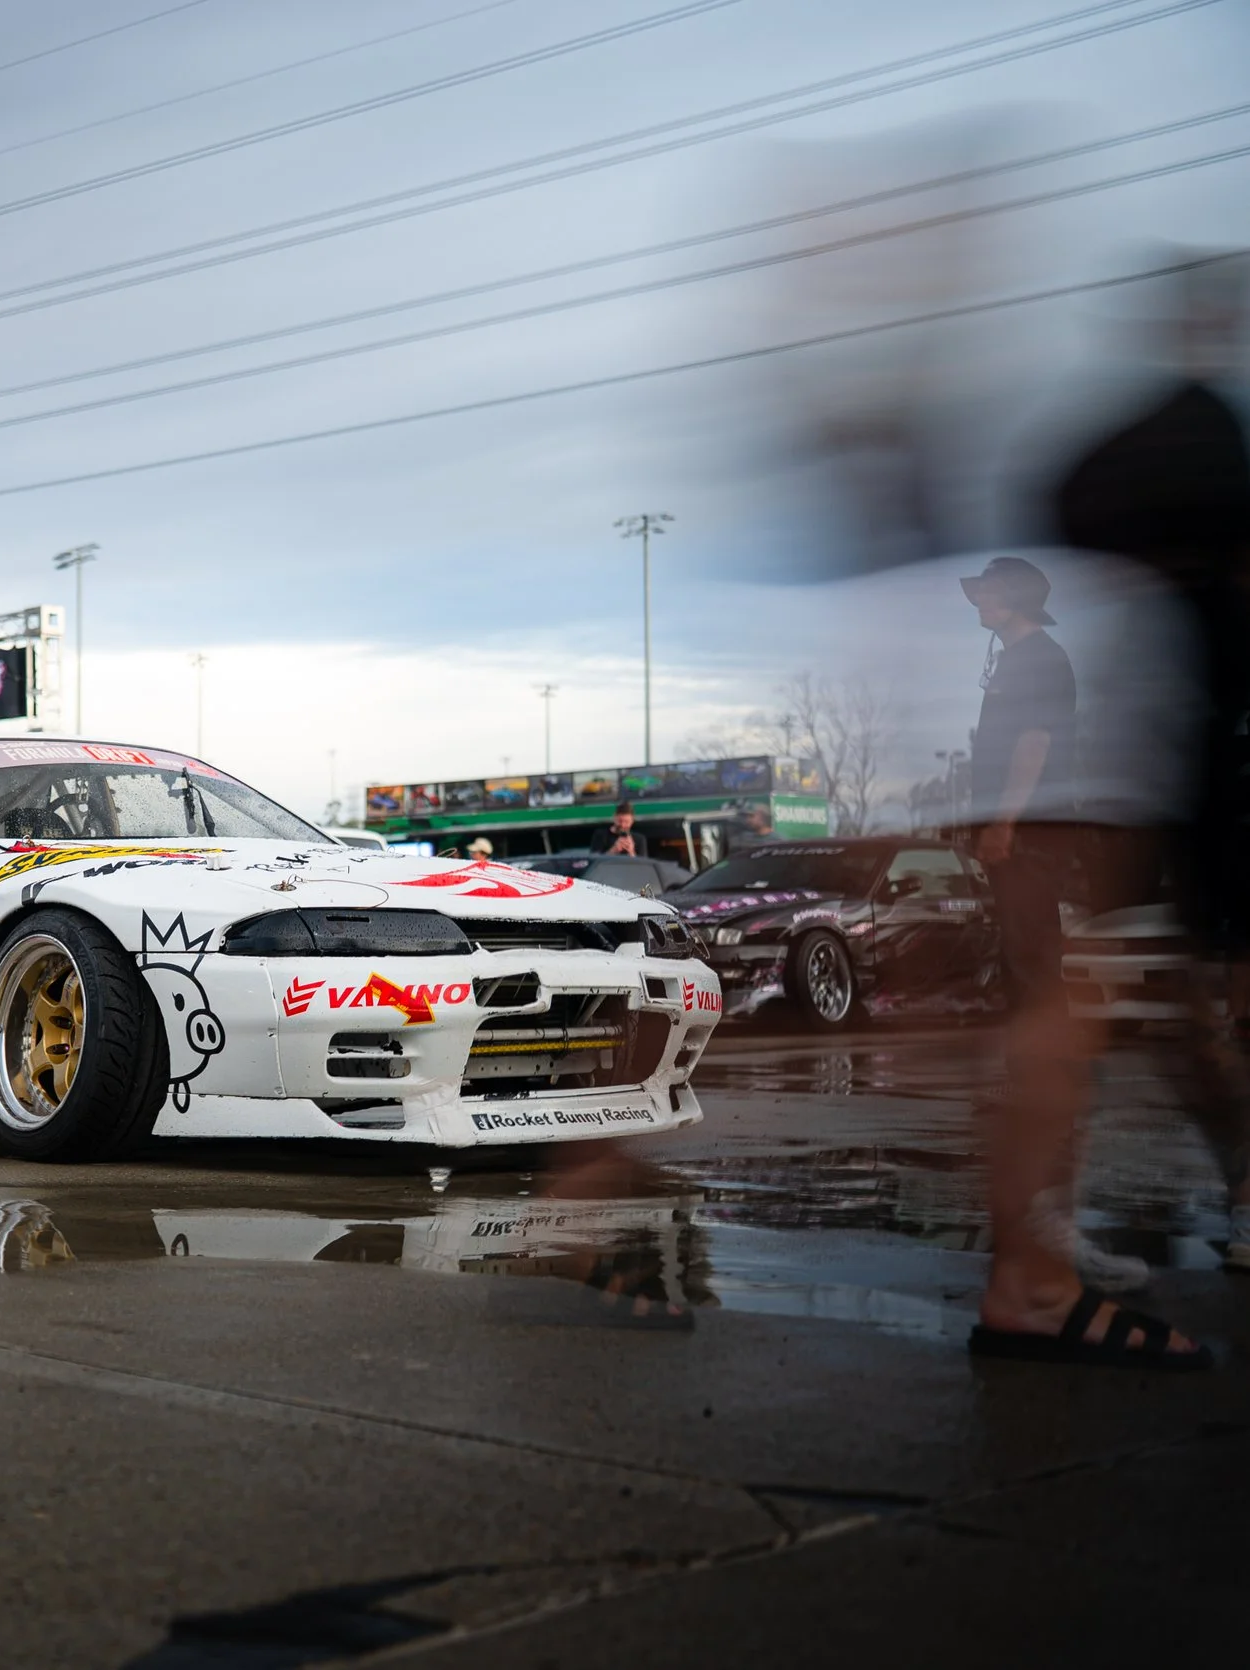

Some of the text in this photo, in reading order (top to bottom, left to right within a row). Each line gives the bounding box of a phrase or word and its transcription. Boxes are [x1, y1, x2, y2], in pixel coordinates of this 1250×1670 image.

[3, 746, 89, 760] FORMULA
[85, 747, 152, 765] DRIFT
[492, 1106, 654, 1128] Rocket Bunny Racing
